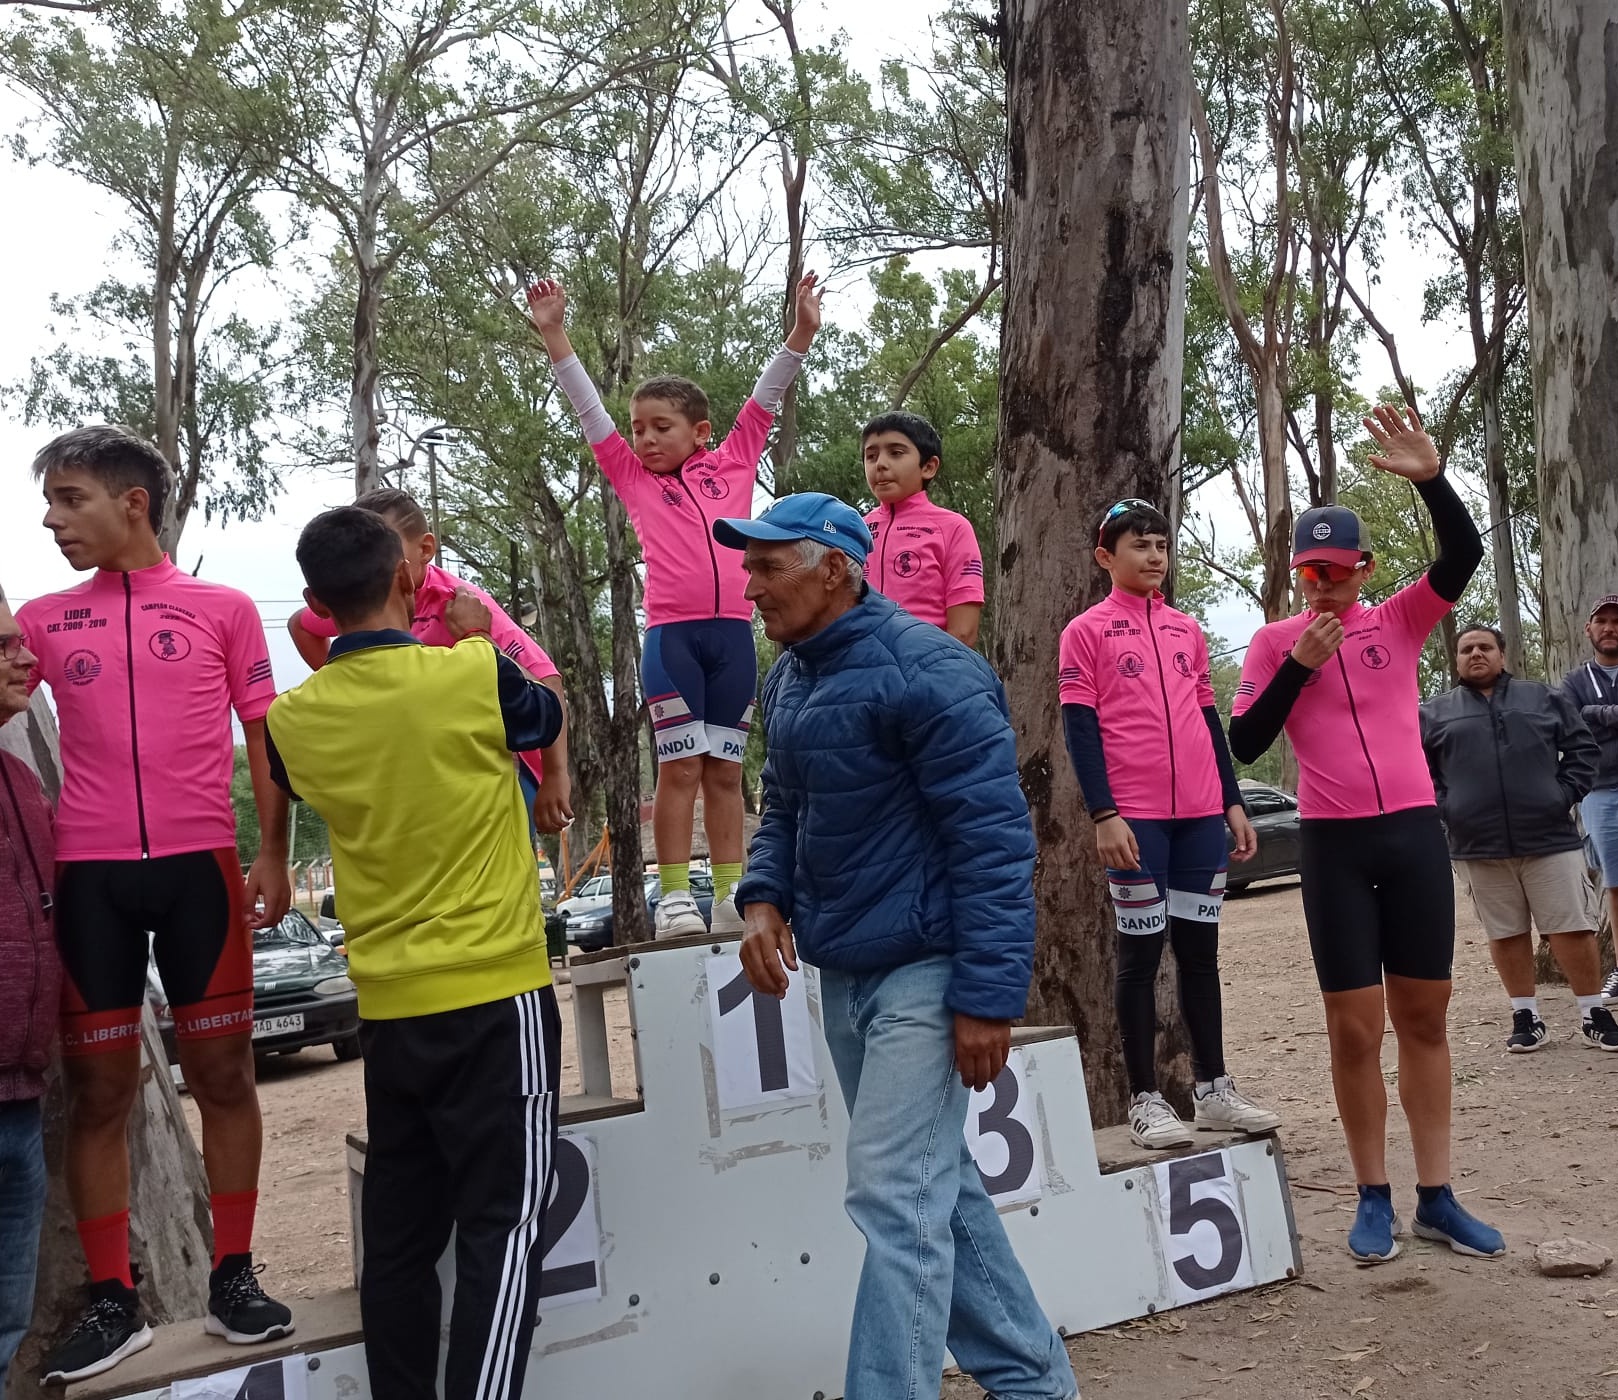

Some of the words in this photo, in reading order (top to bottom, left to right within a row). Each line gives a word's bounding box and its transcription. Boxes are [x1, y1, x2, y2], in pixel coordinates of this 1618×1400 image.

[63, 621, 83, 631] 2009
[88, 618, 107, 629] 2010
[64, 608, 92, 620] LIDER
[1112, 620, 1129, 629] LIDER
[276, 1015, 302, 1028] 4643
[717, 968, 789, 1092] 1
[972, 1063, 1034, 1197] 3
[539, 1138, 598, 1299] 2
[1168, 1151, 1243, 1291] 5
